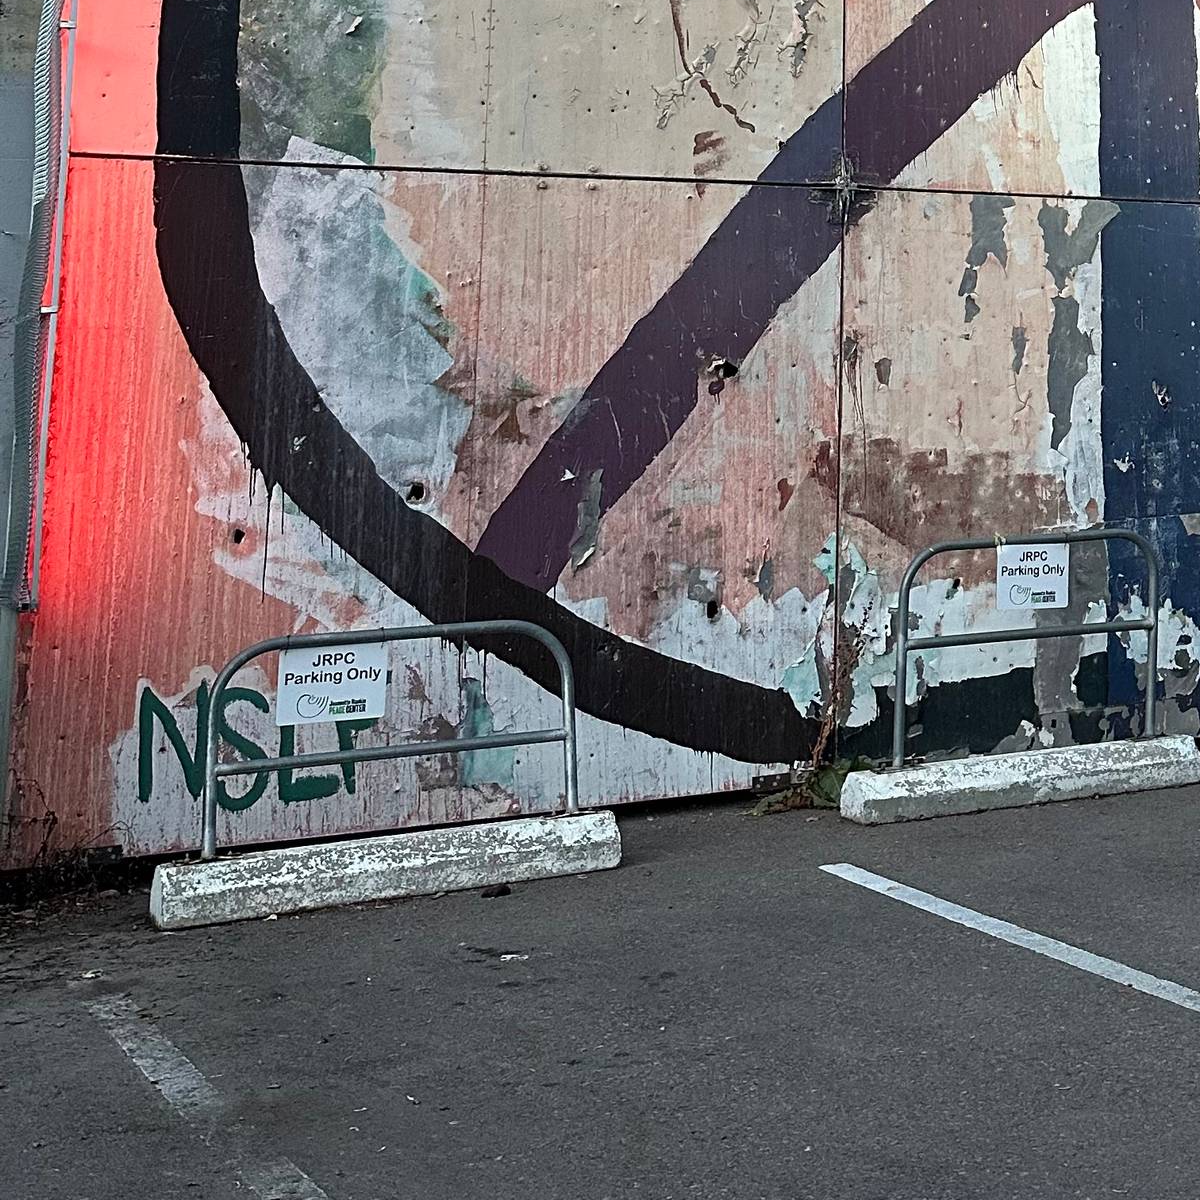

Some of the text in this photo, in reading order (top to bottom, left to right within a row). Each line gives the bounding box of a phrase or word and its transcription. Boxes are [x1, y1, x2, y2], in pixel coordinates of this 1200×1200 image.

[1019, 551, 1048, 562] JRPC
[1001, 564, 1065, 578] Parking Only
[312, 652, 355, 667] JRPC
[284, 666, 382, 686] Parking Only
